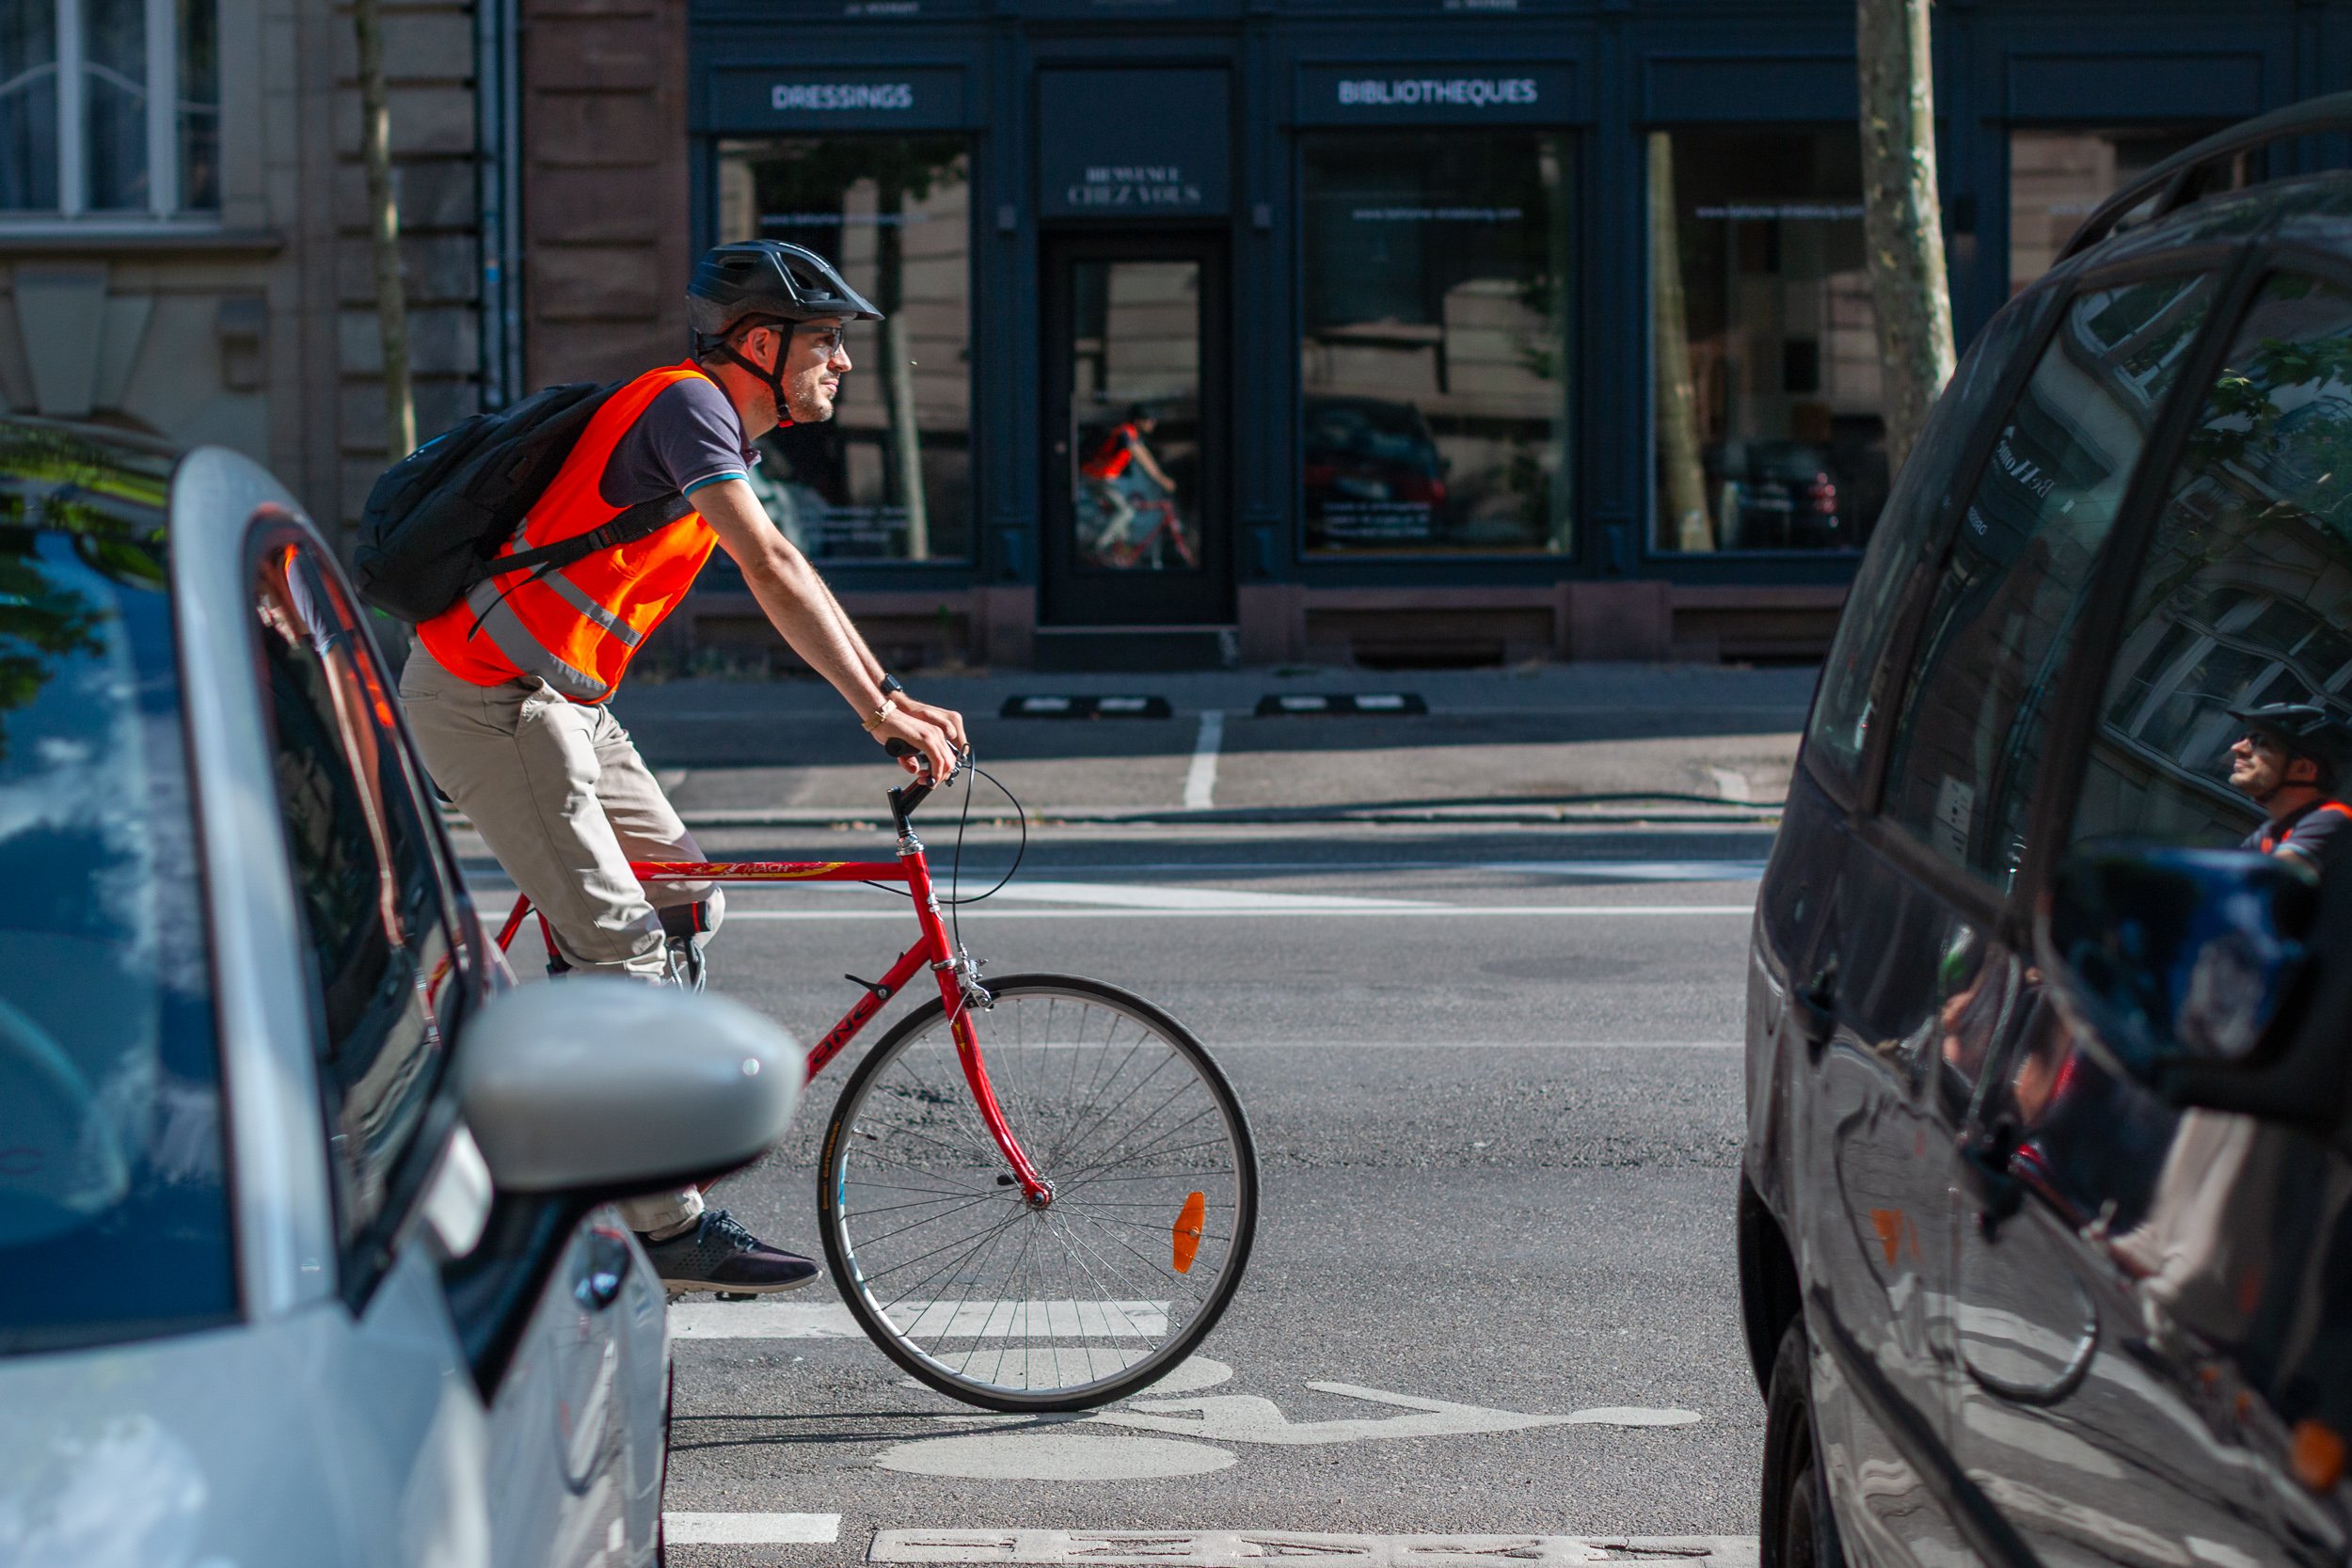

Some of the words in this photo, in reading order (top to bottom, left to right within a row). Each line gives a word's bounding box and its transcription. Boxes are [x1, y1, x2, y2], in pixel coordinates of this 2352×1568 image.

[771, 85, 913, 110] DRESSINGS
[1339, 79, 1537, 105] BIBLIOTHEQUES
[742, 863, 787, 875] MACH
